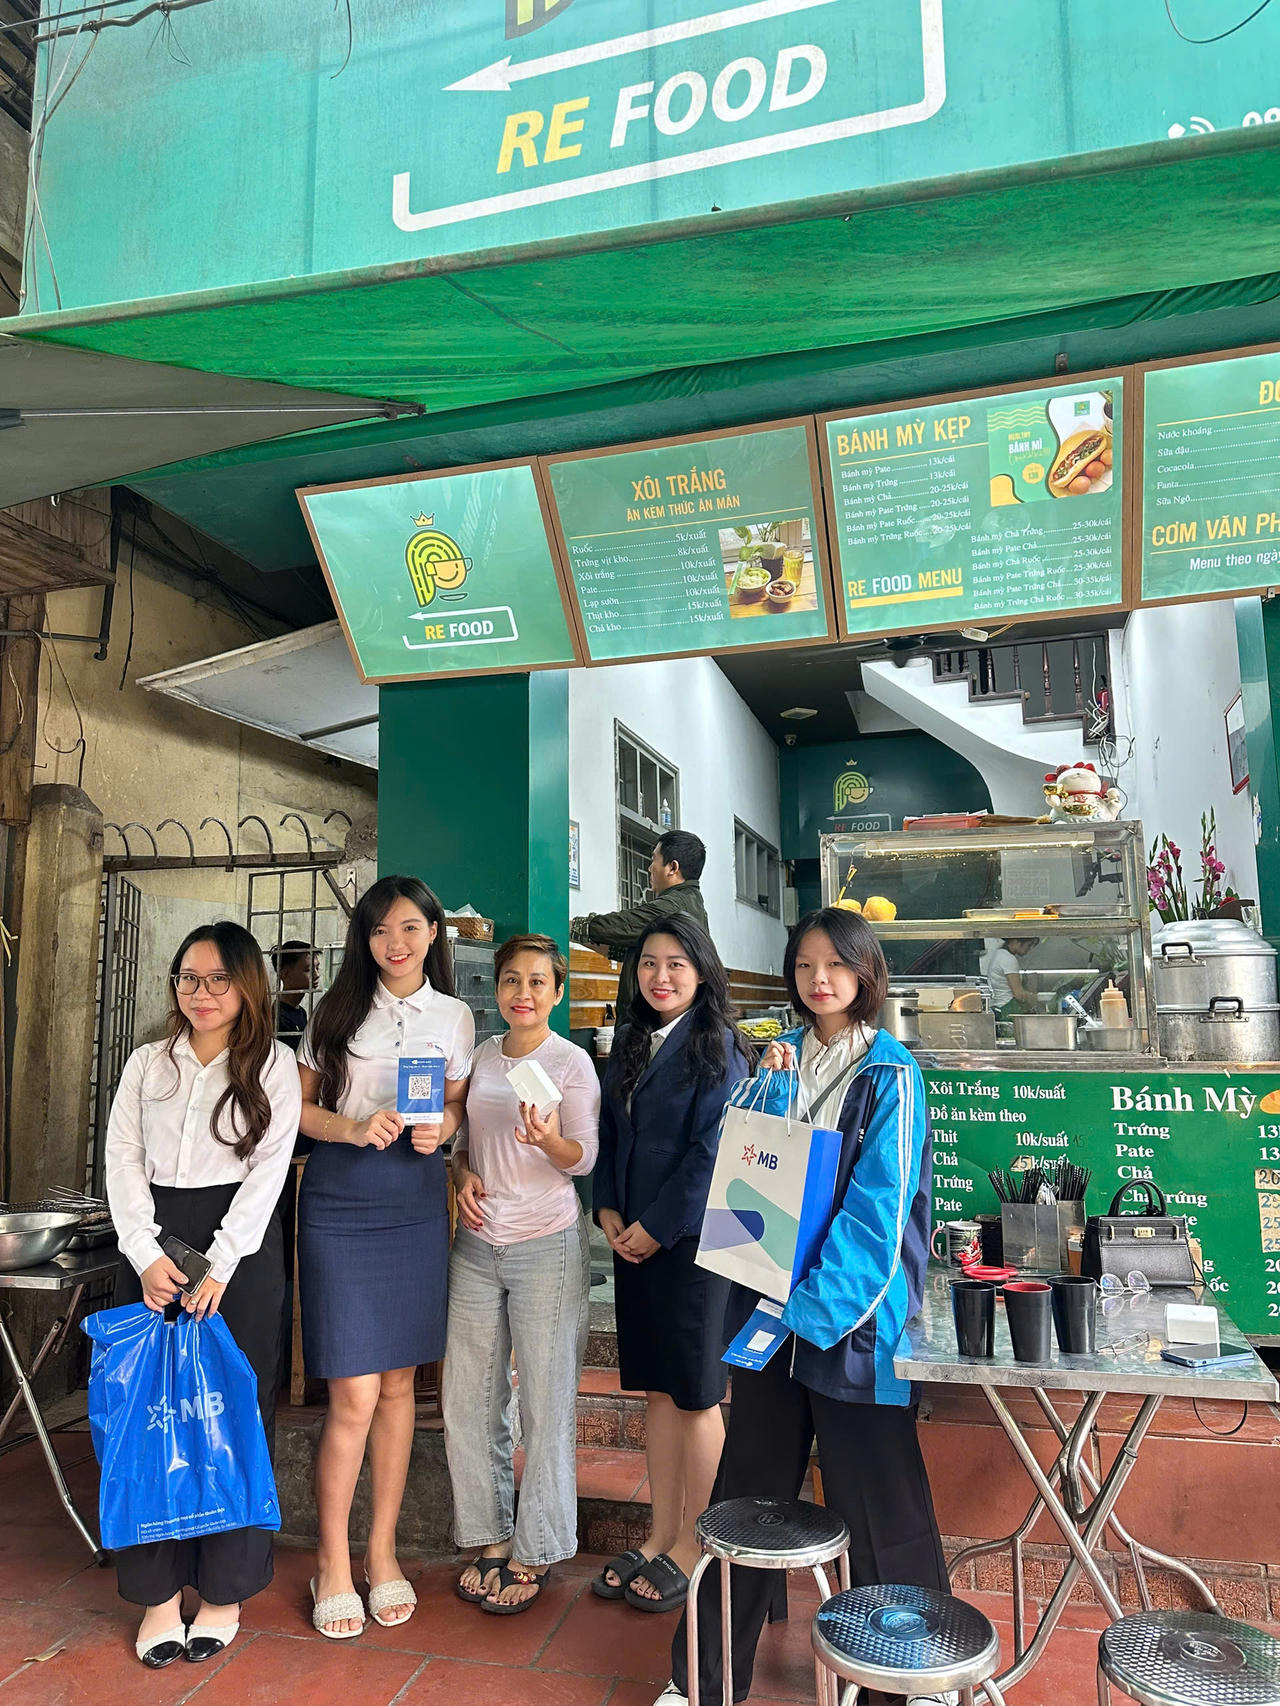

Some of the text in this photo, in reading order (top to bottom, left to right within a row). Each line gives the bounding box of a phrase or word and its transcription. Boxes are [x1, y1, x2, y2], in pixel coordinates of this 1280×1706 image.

[495, 44, 828, 174] RE FOOD
[837, 416, 972, 456] BÁNH MỲ KẸP
[842, 469, 860, 478] Bánh
[1157, 462, 1195, 473] Cocacola
[632, 466, 726, 501] XÔI TRẮNG
[843, 482, 861, 492] Bánh
[1157, 480, 1179, 489] Fanta
[844, 496, 862, 506] Bánh
[1173, 494, 1191, 505] Ngô
[845, 510, 864, 519] Bánh
[879, 507, 893, 515] Pate
[847, 523, 864, 532] Bánh
[1152, 521, 1197, 546] CƠM
[1206, 515, 1246, 540] VĂN
[848, 536, 866, 546] Bánh
[971, 533, 990, 543] Bánh
[972, 547, 990, 556] Bánh
[972, 561, 991, 570] Bánh
[1190, 557, 1220, 570] Menu
[1226, 553, 1251, 566] theo
[848, 568, 962, 597] RE FOOD MENU
[973, 575, 991, 584] Bánh
[581, 586, 598, 594] Pate
[974, 588, 991, 597] Bánh
[1007, 585, 1022, 593] Pate
[974, 601, 992, 610] Bánh
[425, 620, 493, 640] RE FOOD
[834, 822, 880, 831] RE FOOD
[929, 1080, 1066, 1099] Xôi Trắng 10k/suất
[1110, 1086, 1257, 1119] Bánh Mỳ
[930, 1104, 1026, 1122] Đồ ăn kèm theo
[1114, 1123, 1280, 1139] Trứng 13
[932, 1129, 1069, 1147] Thịt 10k/suất
[1115, 1144, 1154, 1157] Pate
[757, 1151, 778, 1170] MB
[933, 1151, 958, 1166] Chả
[1118, 1166, 1153, 1179] Chả
[934, 1174, 973, 1192] Trứng
[935, 1197, 962, 1211] Pate
[180, 1391, 225, 1423] MB
